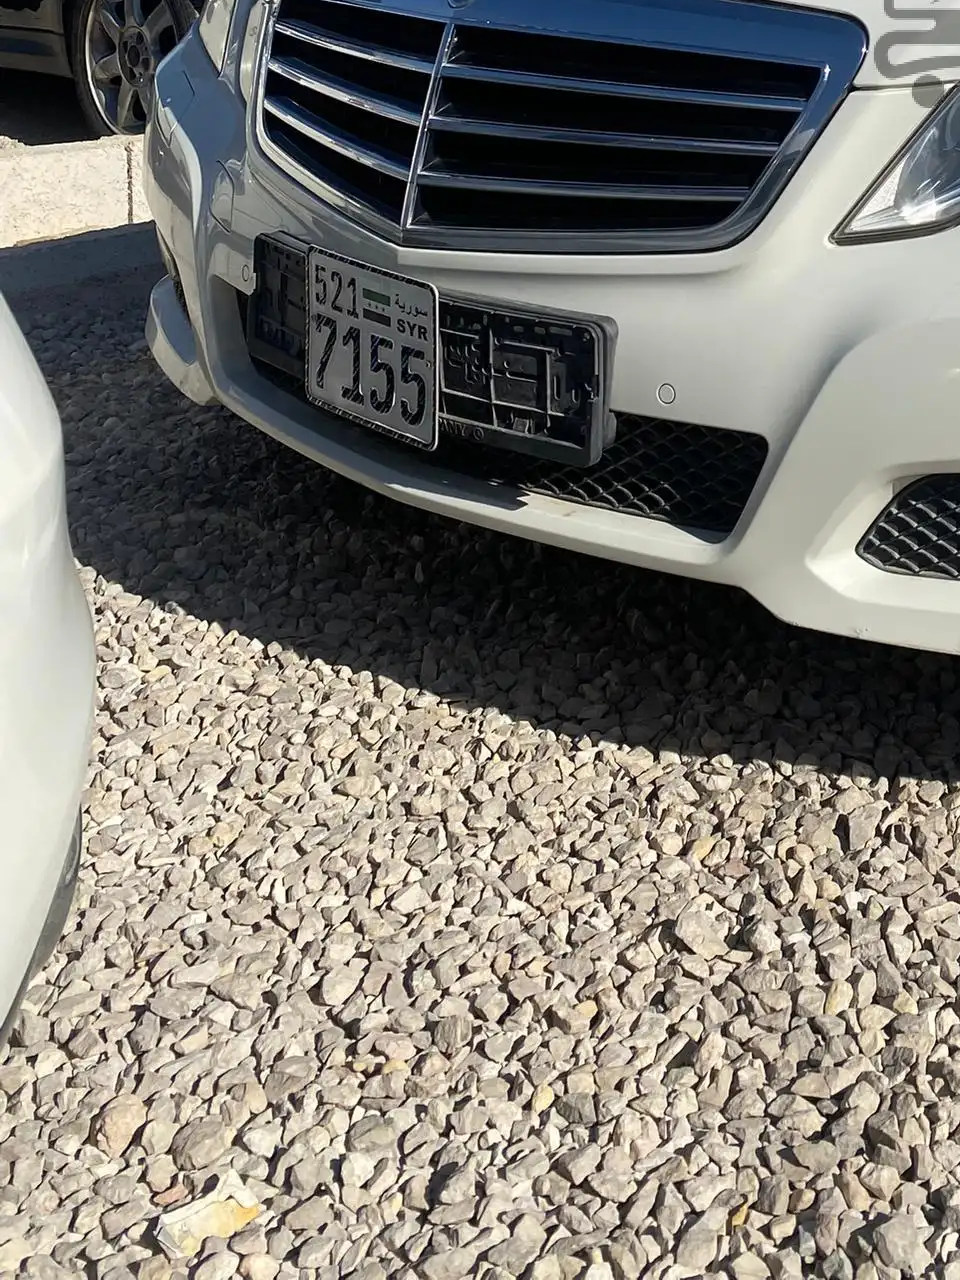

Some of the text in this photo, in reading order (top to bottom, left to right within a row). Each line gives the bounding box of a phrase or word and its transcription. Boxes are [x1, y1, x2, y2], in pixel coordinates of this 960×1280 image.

[315, 264, 359, 319] 521
[394, 293, 429, 318] سورية
[396, 318, 429, 342] SYR
[314, 313, 427, 427] 7155
